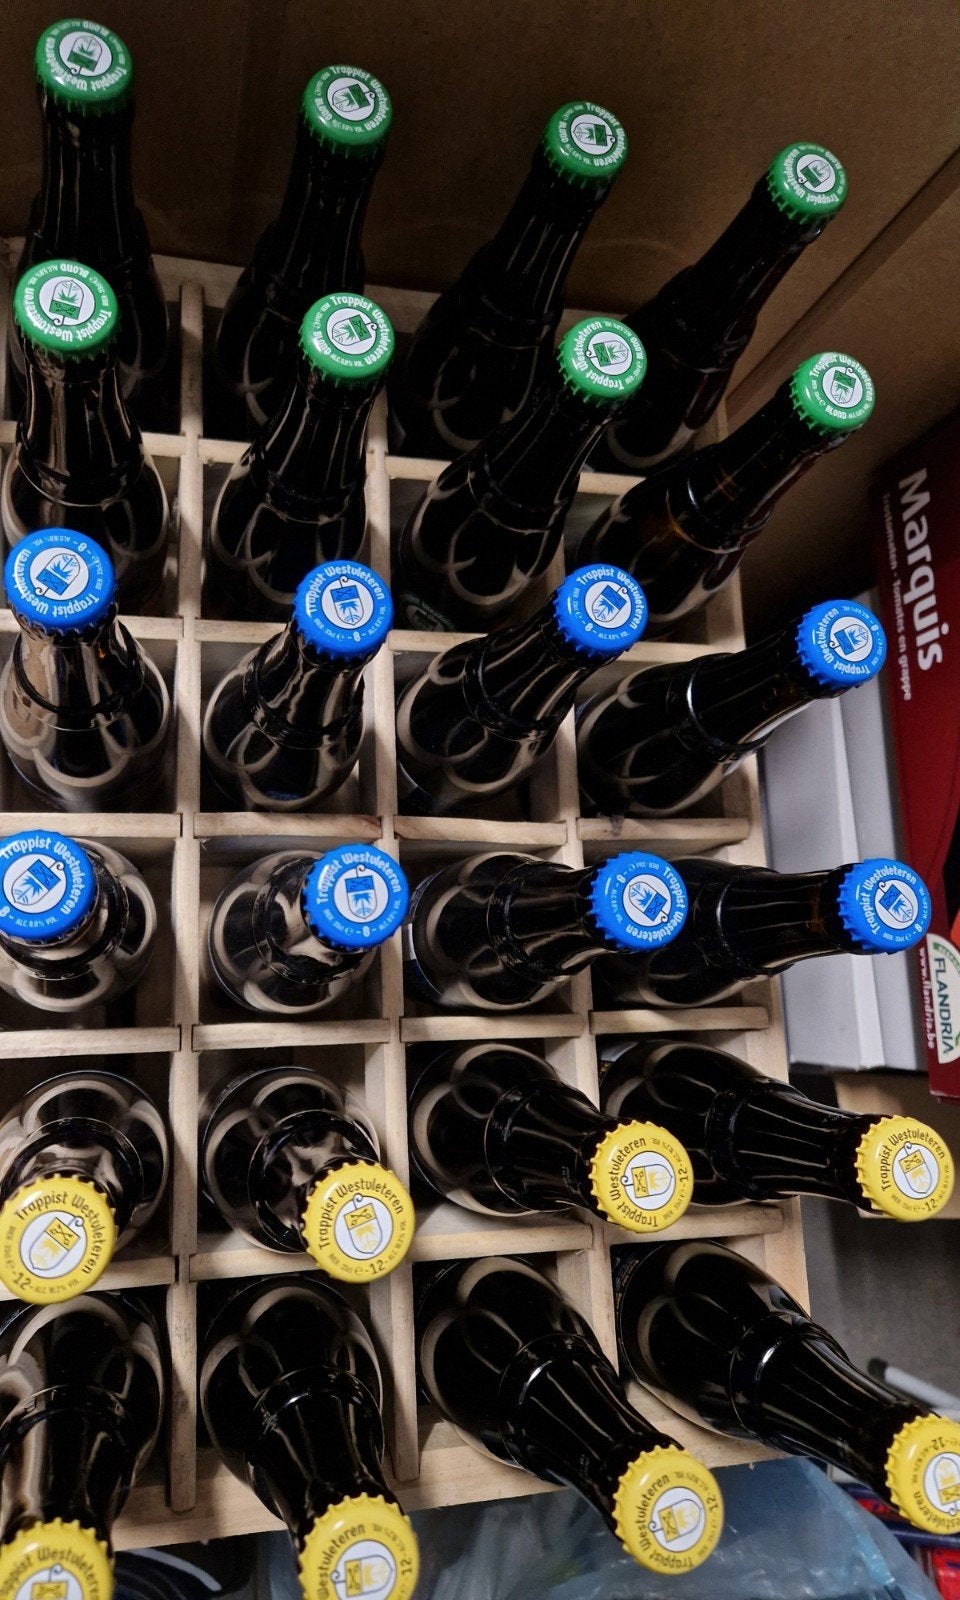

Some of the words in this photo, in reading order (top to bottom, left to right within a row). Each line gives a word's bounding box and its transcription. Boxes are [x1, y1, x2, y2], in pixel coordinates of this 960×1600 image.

[330, 296, 372, 310] Trappist
[576, 567, 614, 585] Trappist
[898, 467, 949, 671] Marquis
[52, 593, 99, 617] Trappist
[663, 867, 685, 909] Trappist
[860, 892, 880, 934] Trappist
[934, 957, 954, 1054] FLANDRIA
[880, 1145, 892, 1191] Trappist
[15, 1191, 68, 1219] Trappist
[319, 1197, 337, 1250] Trappist
[617, 1201, 658, 1227] Trappist
